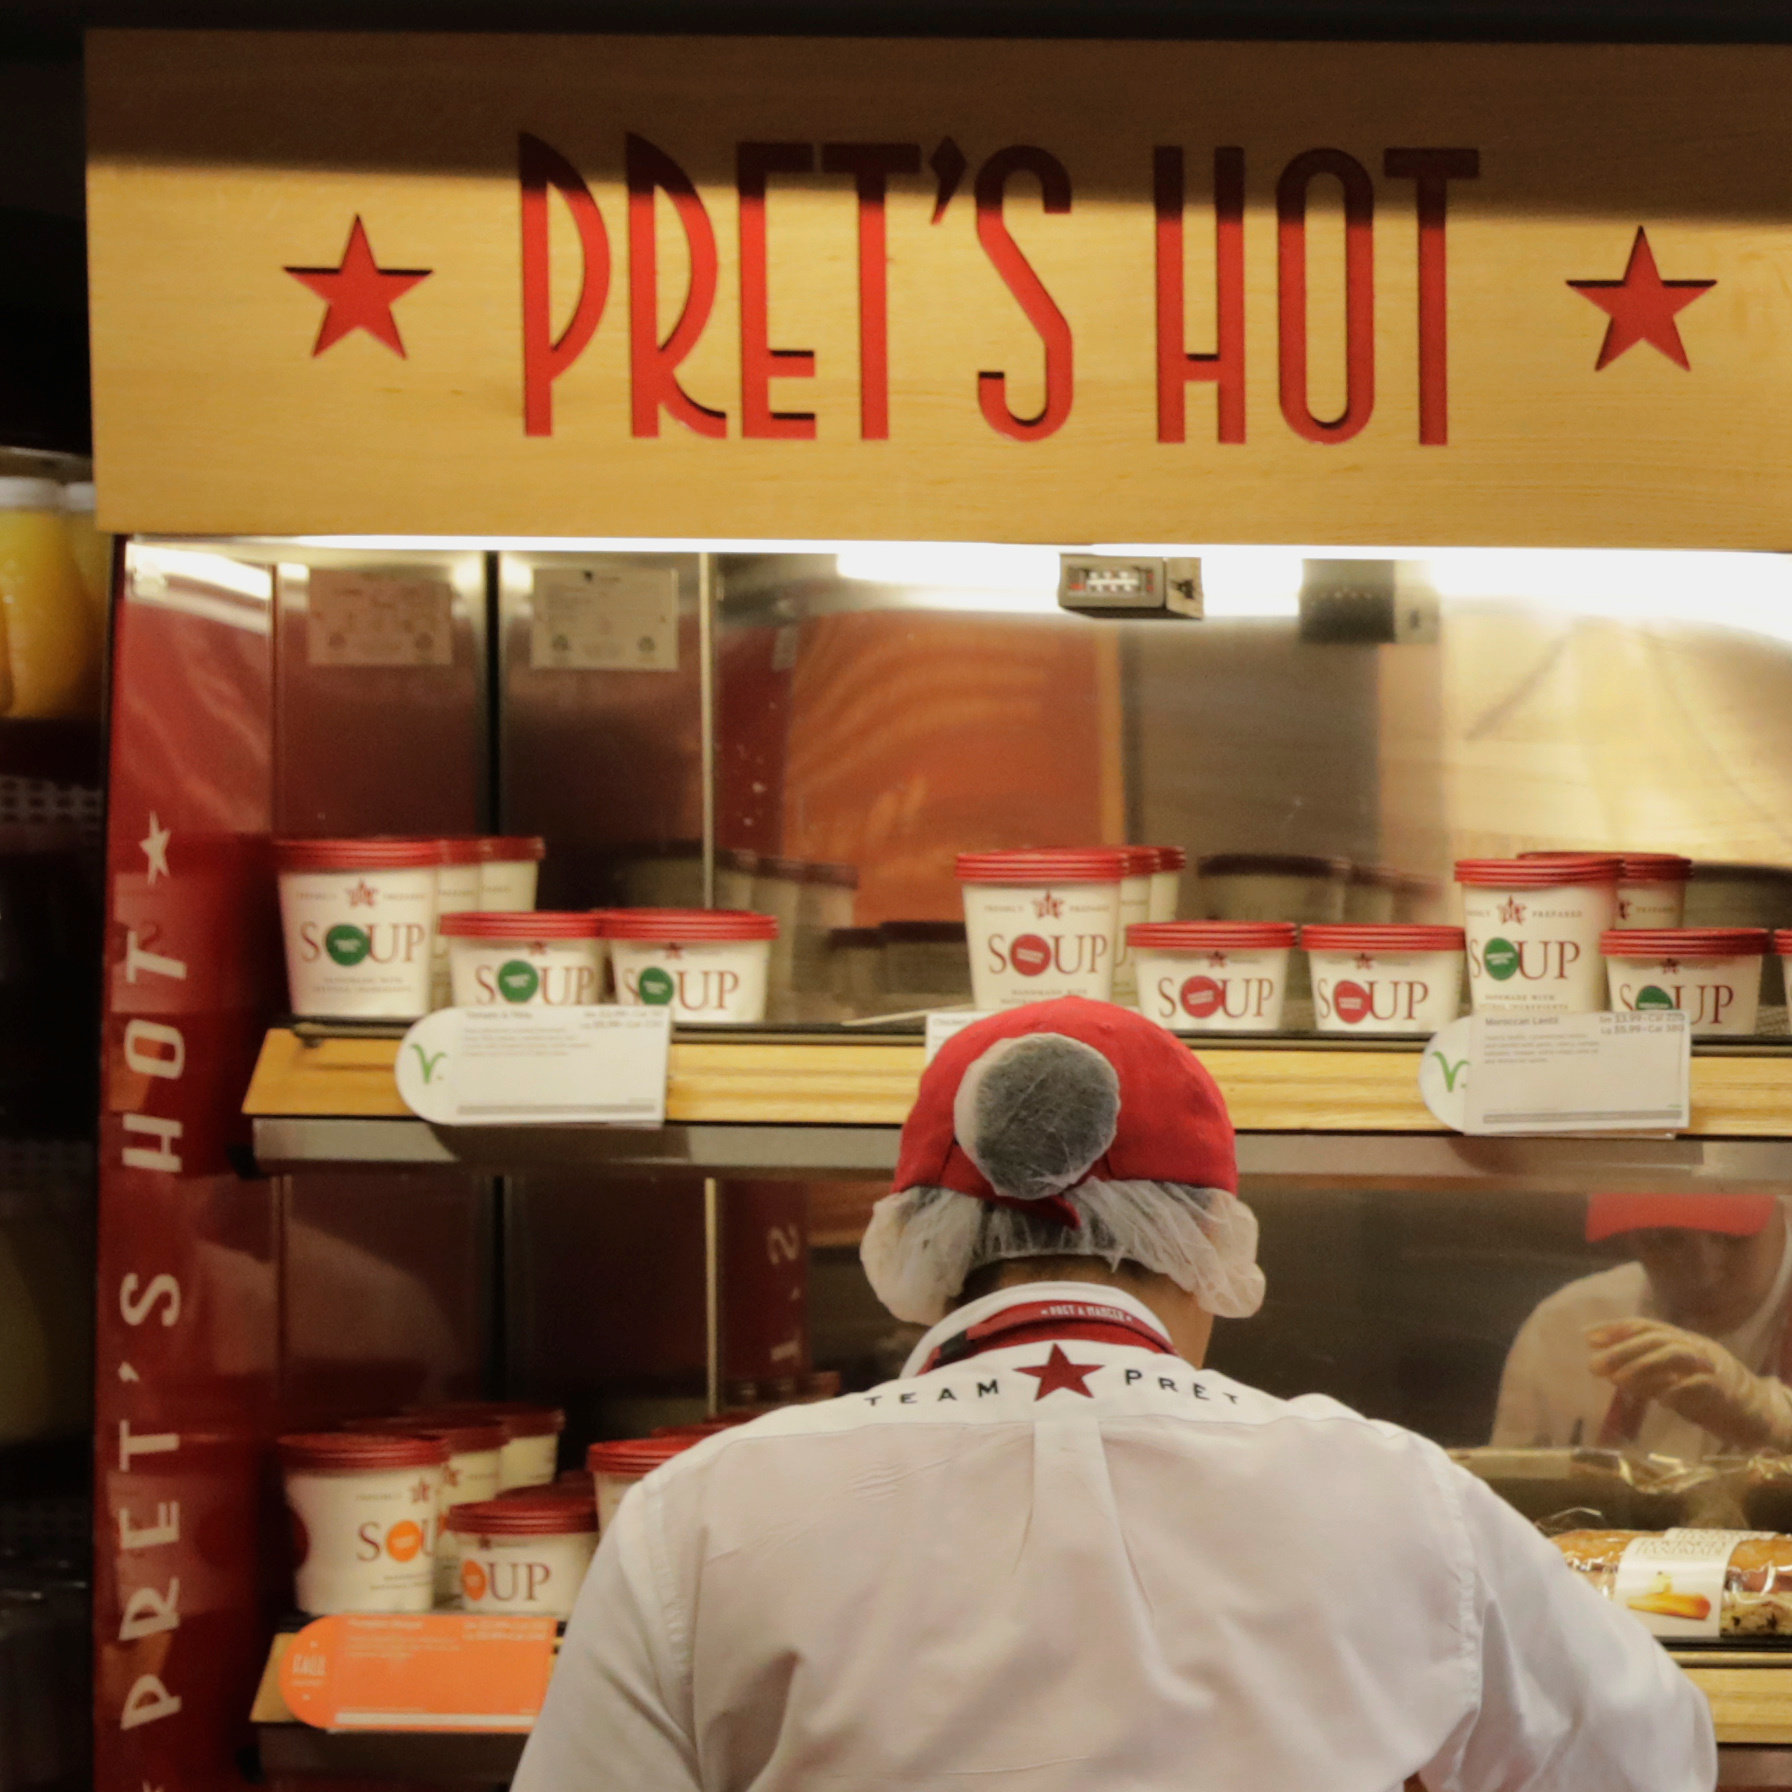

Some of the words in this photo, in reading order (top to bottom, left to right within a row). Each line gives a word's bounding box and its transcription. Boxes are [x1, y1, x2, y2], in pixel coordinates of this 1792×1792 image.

[519, 130, 1075, 443] PRET'S
[1153, 145, 1481, 447] HOT
[301, 921, 425, 963] SUP
[988, 933, 1109, 975] SUP
[1470, 939, 1581, 981] SUP
[475, 964, 596, 1006] SUP
[624, 968, 740, 1011] SUP
[1158, 977, 1274, 1019] SUP
[1318, 979, 1429, 1021] SUP
[1620, 984, 1734, 1025] SUP
[121, 931, 187, 1173] HOT
[863, 1380, 999, 1407] TEAM
[1124, 1369, 1238, 1405] PRET
[119, 1273, 182, 1731] PRET'S
